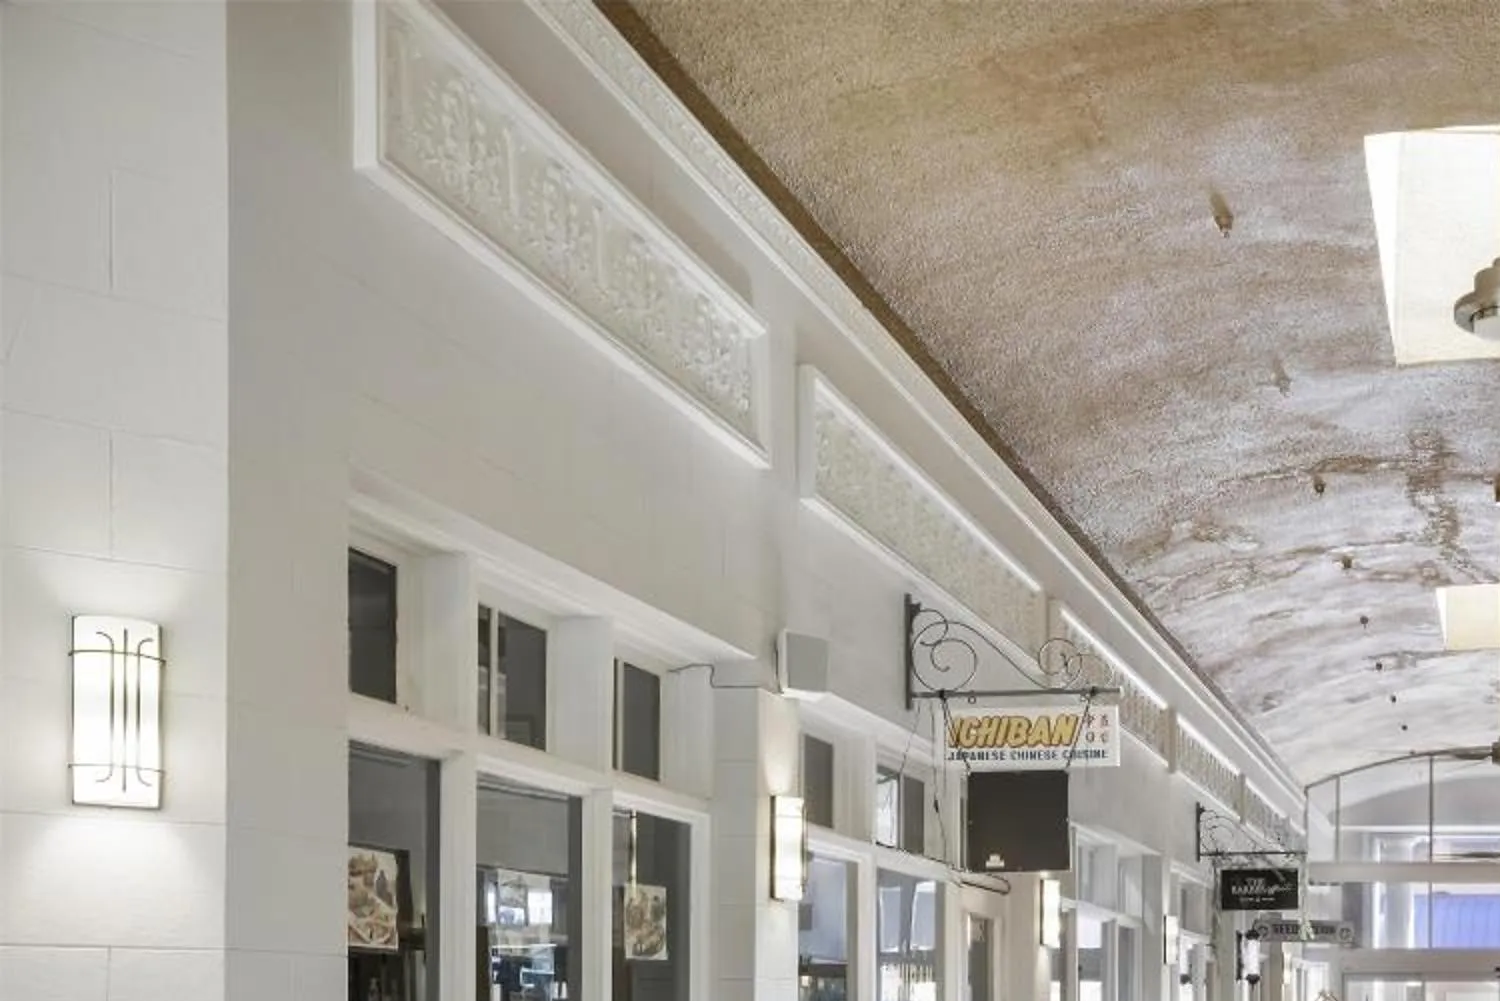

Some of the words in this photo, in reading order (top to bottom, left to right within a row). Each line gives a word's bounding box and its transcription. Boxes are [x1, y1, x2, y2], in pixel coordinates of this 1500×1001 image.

[948, 714, 1079, 748] ICHIBAN
[948, 750, 1006, 761] JAPANESE
[1010, 750, 1059, 761] CHINESE
[1062, 749, 1109, 760] CUISINE
